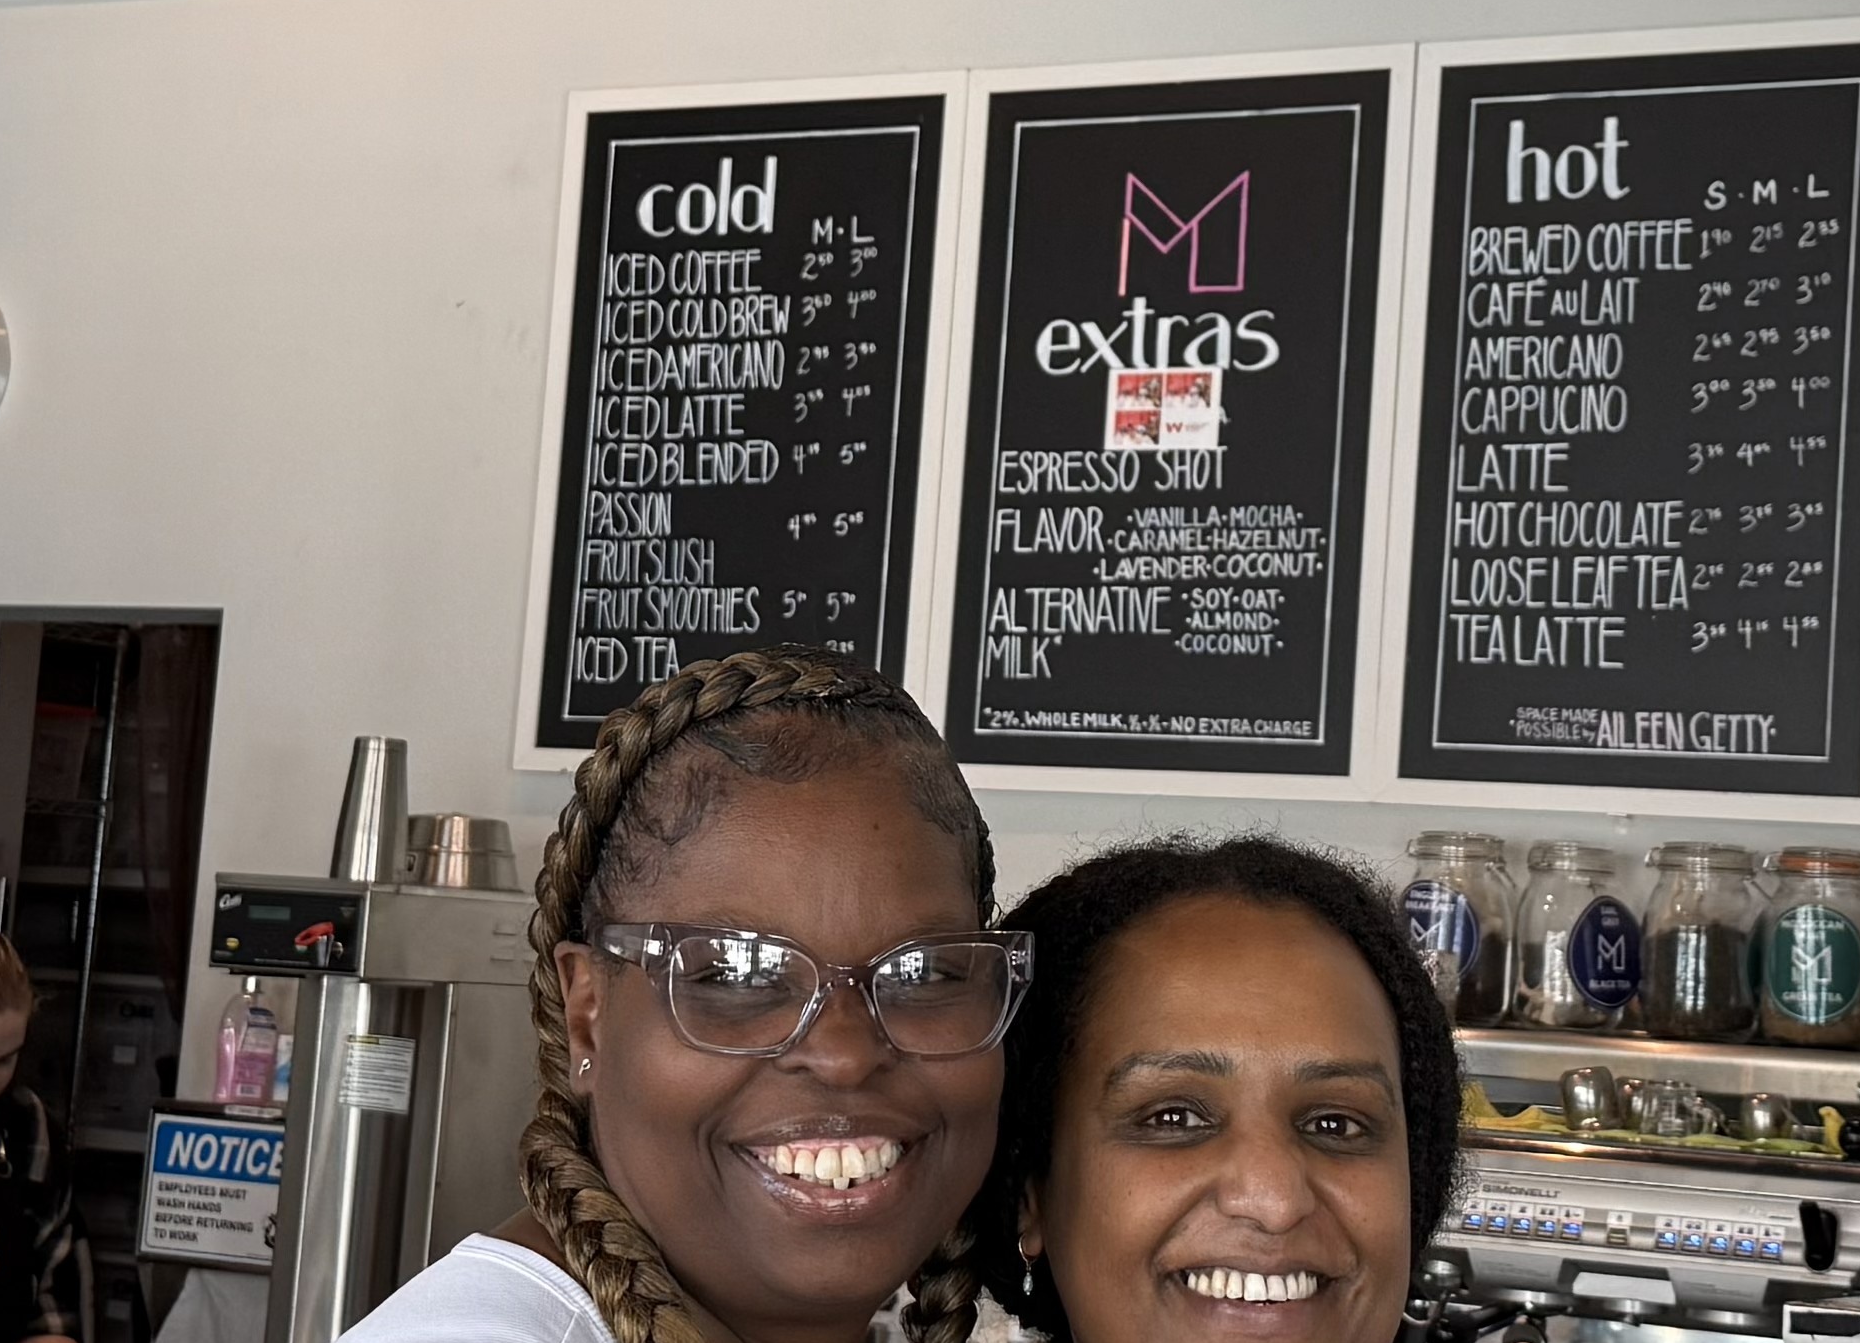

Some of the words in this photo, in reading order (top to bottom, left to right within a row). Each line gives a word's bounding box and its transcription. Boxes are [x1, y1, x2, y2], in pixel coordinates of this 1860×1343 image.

[1507, 117, 1630, 203] hot
[637, 156, 779, 237] cold
[1704, 180, 1727, 210] S
[1753, 179, 1777, 205] M
[1807, 173, 1830, 198] L
[606, 252, 666, 296] ICED
[669, 248, 761, 295] COFFEE
[1469, 224, 1580, 277] BREWED
[1587, 218, 1694, 272] COFFEE
[604, 299, 664, 344] ICED
[667, 297, 727, 339] COLD
[728, 295, 791, 338] BREW
[1580, 276, 1639, 326] LAIT
[1036, 296, 1279, 376] extras
[1464, 332, 1623, 381] AMERICANO
[600, 347, 663, 392] ICED
[662, 339, 785, 390] AMERICANO
[594, 395, 660, 440] ICED
[662, 393, 744, 440] LATTE
[1461, 383, 1628, 435] CAPPUCINO
[592, 443, 658, 487] ICED
[659, 440, 779, 486] BLENDED
[999, 450, 1139, 495] ESPRESSO
[1155, 446, 1228, 490] SHOT
[1456, 442, 1570, 493] LATTE
[589, 492, 671, 537] PASSION
[995, 506, 1104, 553] FLAVOR
[1453, 501, 1517, 549] HOT
[1518, 500, 1684, 549] CHOCOLATE
[584, 539, 646, 583] FRUIT
[645, 538, 715, 585] SLUSH
[1451, 557, 1547, 607] LOOSE
[1551, 555, 1628, 610] LEAF
[1634, 554, 1689, 611] TEA
[580, 588, 642, 631] FRUIT
[644, 586, 760, 634] SMOOTHIES
[989, 586, 1171, 635] ALTERNATIVE
[576, 637, 628, 683] ICED
[632, 636, 680, 683] TEA
[1449, 613, 1506, 664] TEA
[1514, 615, 1626, 669] LATTE
[1516, 706, 1559, 721] SPACE
[1561, 708, 1599, 724] MADE
[1596, 710, 1684, 751] AILEEN
[167, 1130, 284, 1178] NOTICE
